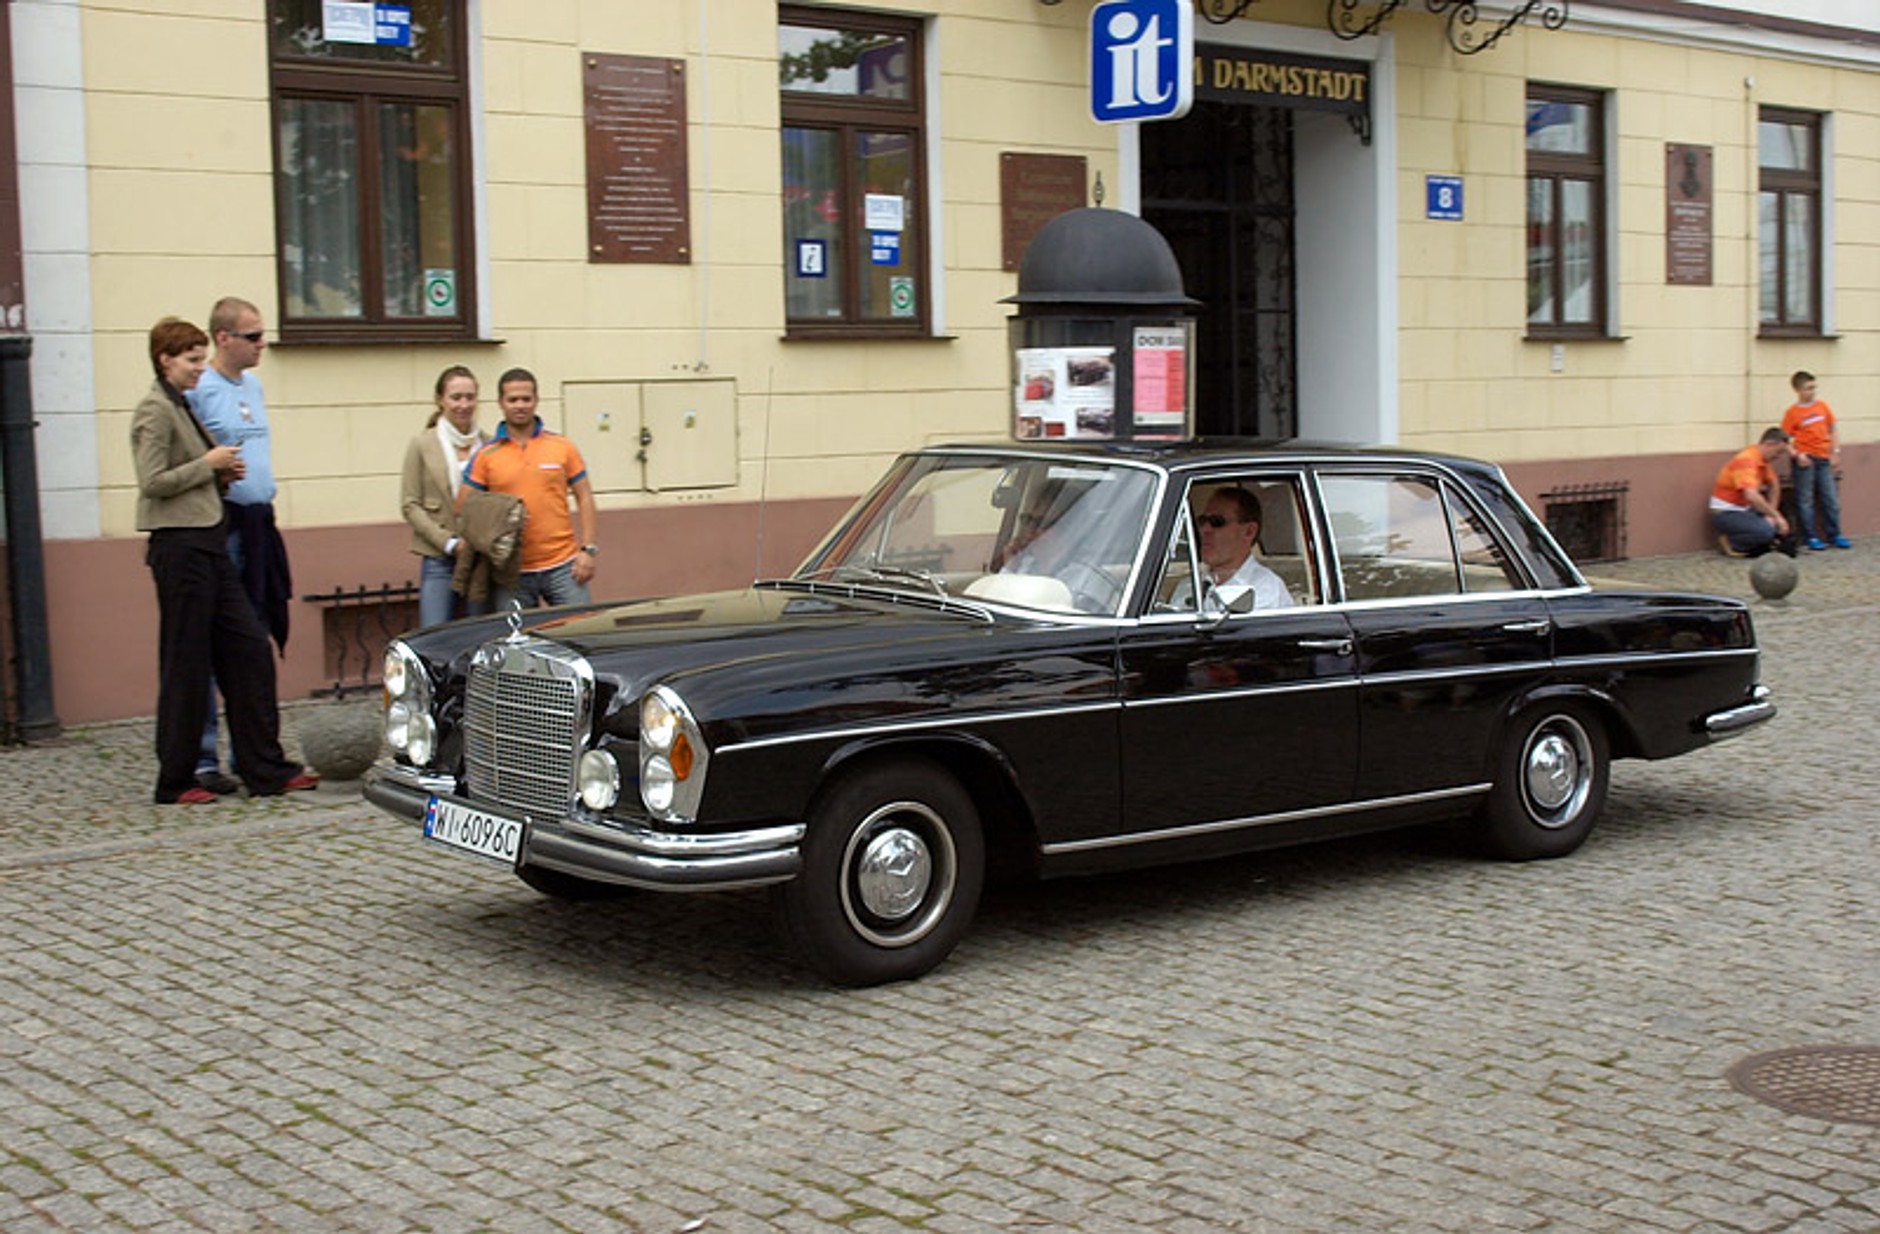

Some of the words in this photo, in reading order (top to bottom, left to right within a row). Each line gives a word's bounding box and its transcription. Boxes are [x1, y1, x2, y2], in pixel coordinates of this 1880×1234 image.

[1105, 11, 1174, 109] it
[1212, 58, 1367, 102] DARMSTADT
[1438, 187, 1454, 208] 8
